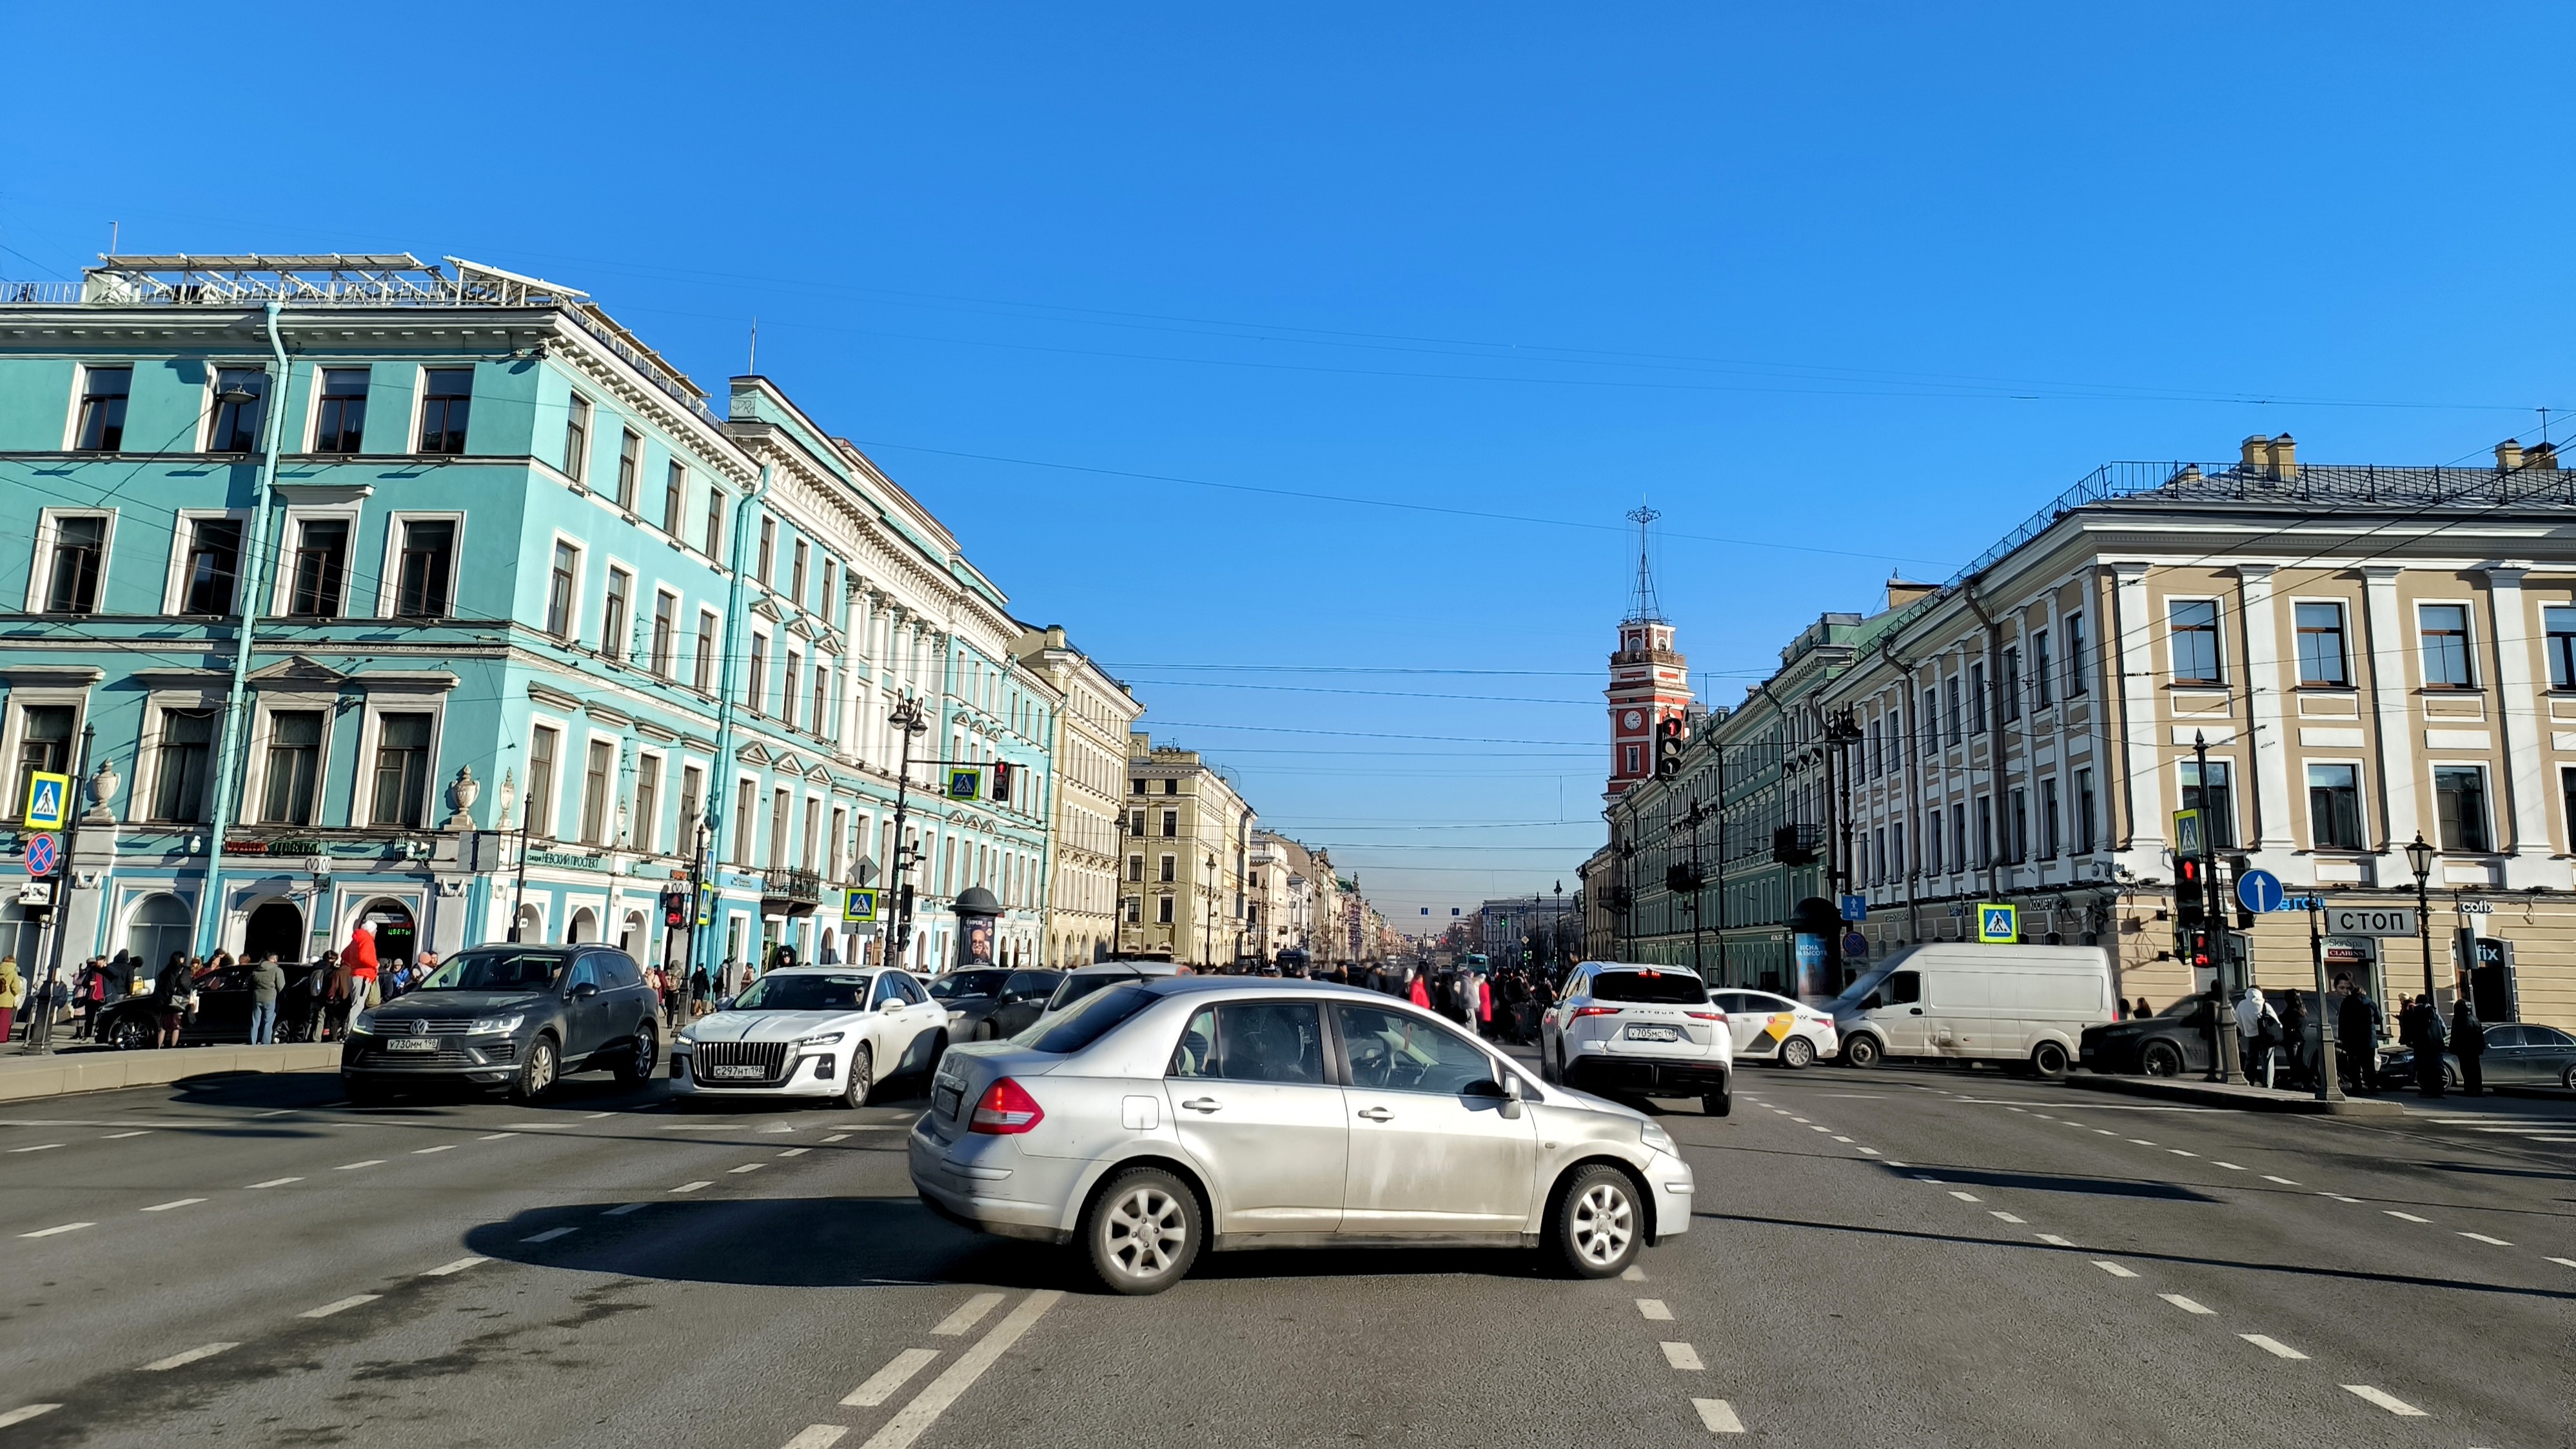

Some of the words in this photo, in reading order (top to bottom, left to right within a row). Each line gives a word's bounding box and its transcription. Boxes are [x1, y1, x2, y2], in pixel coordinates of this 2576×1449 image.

[542, 852, 569, 865] НЕВСКИЙ
[570, 856, 598, 869] ПРОСПЕКТ
[2463, 900, 2495, 912] cofix
[2340, 912, 2404, 930] СТОП
[2328, 938, 2363, 947] SkinSpa
